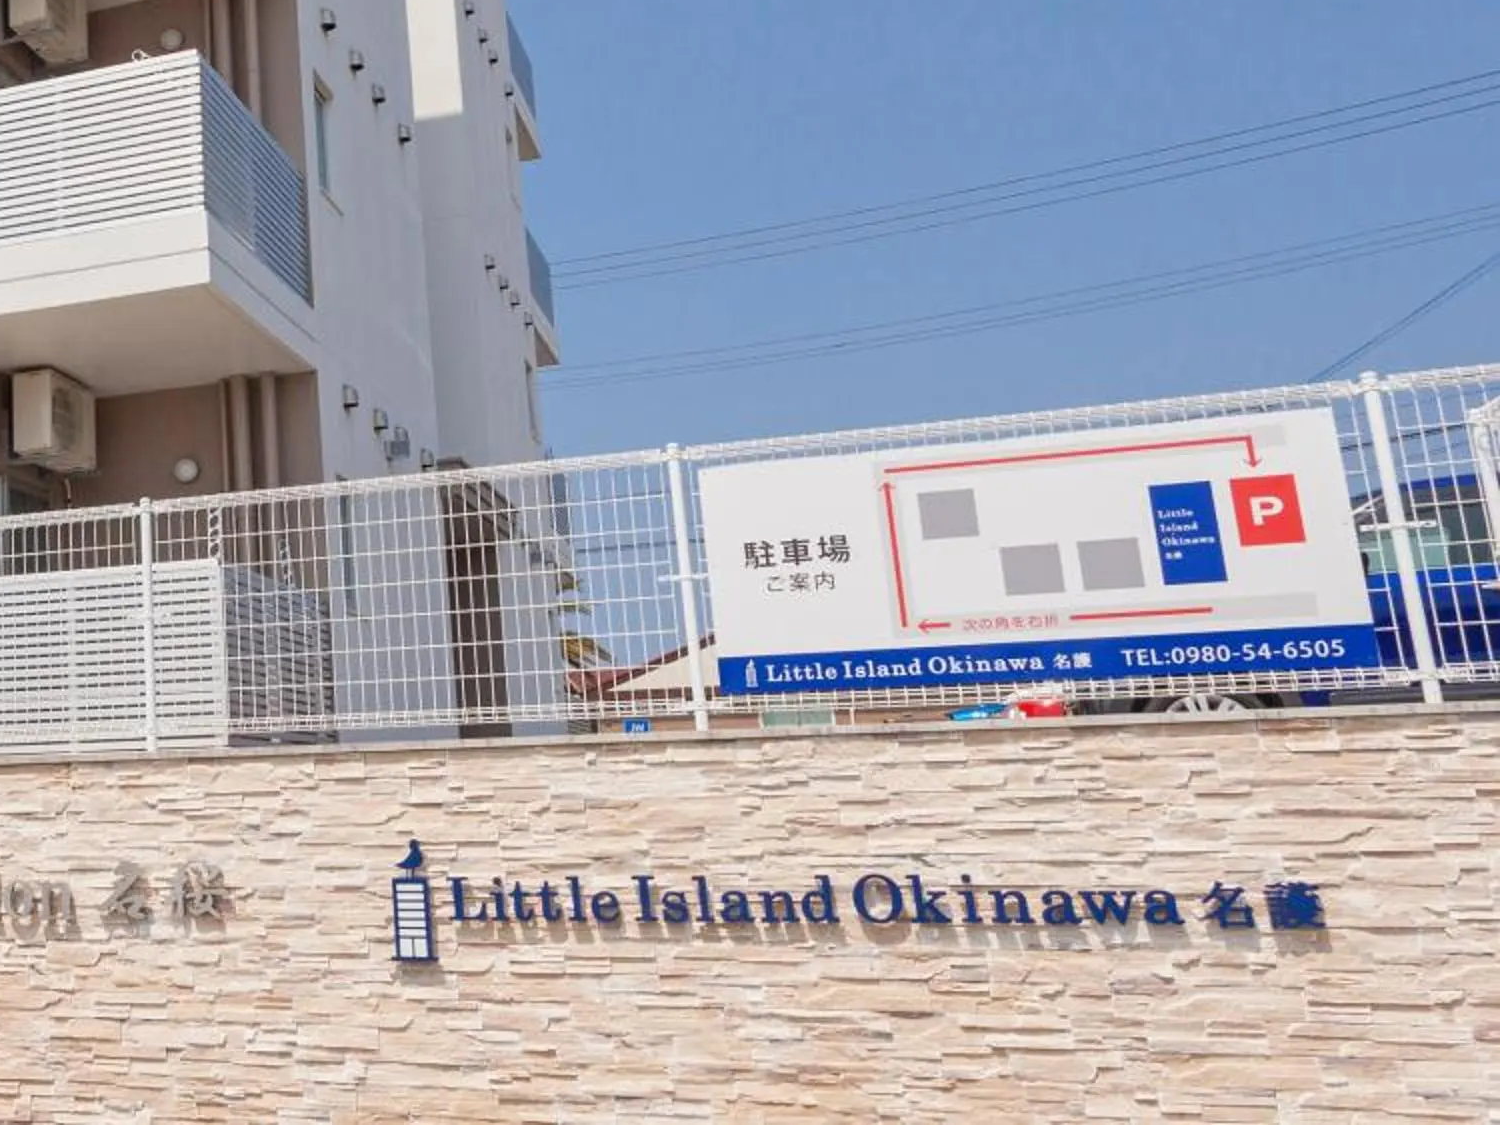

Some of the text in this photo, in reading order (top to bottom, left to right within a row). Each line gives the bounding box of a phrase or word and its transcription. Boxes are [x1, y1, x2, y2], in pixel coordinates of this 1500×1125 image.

[1250, 495, 1284, 525] P
[743, 534, 851, 569] 駐車場
[766, 662, 837, 683] Little
[843, 656, 921, 679] Island
[927, 652, 1044, 675] Okinawa
[1120, 639, 1347, 668] TEL:0980-54-6505
[446, 875, 622, 925] Little
[630, 875, 842, 925] Island
[852, 874, 1186, 926] Okinawa
